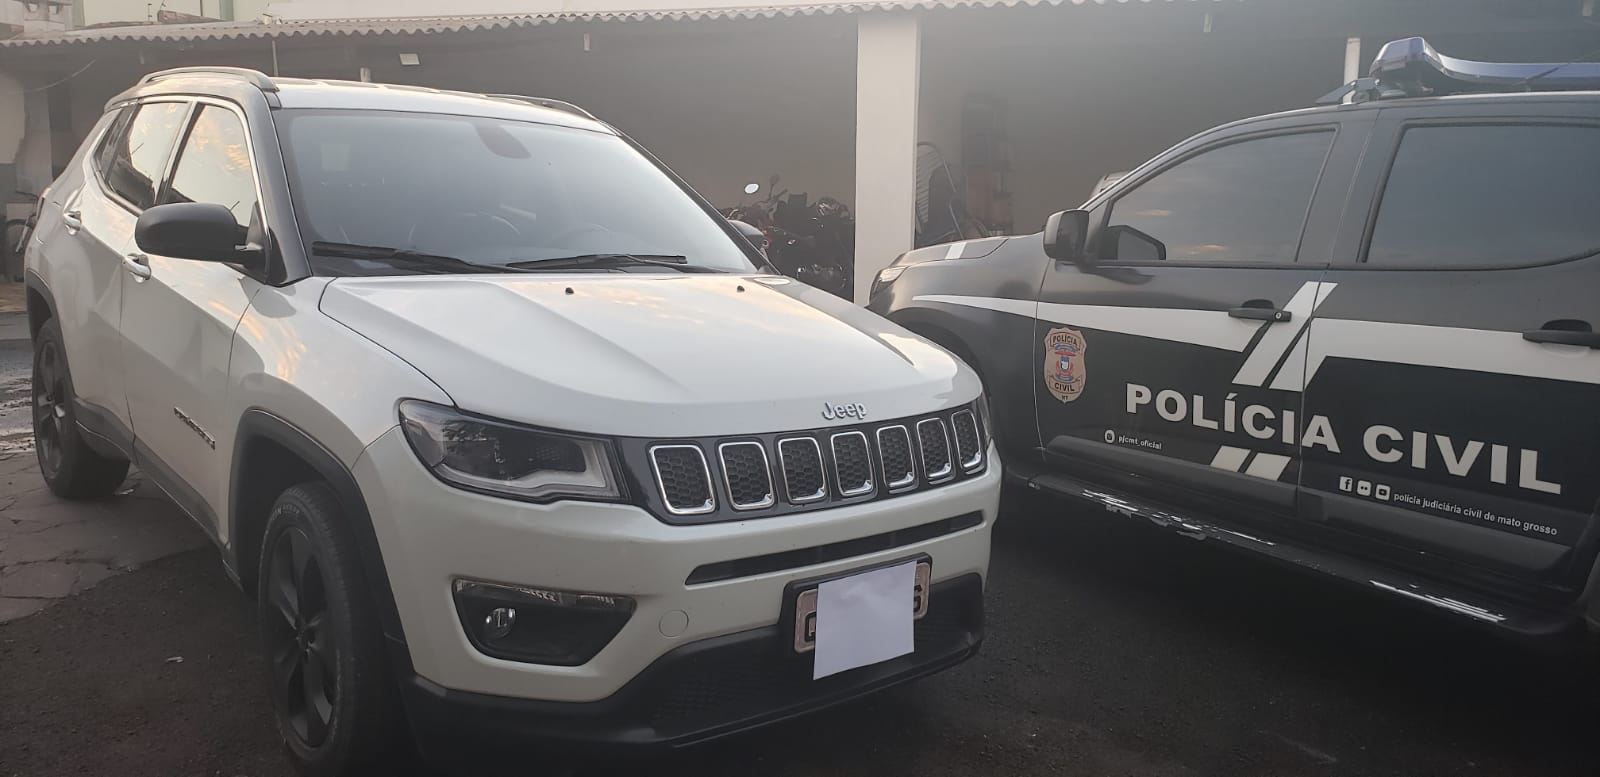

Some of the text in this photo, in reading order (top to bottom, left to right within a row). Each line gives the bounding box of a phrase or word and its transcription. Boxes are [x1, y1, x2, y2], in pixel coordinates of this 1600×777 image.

[1054, 382, 1075, 392] CIVIL
[821, 401, 867, 420] Jeep
[1118, 434, 1162, 450] pjcmt_oficial
[1126, 382, 1561, 495] POLÍCIA CIVIL
[1422, 498, 1462, 514] judiciária
[1463, 507, 1482, 519] civil
[1484, 511, 1496, 522] de
[1497, 515, 1521, 527] mato
[1523, 522, 1558, 536] grosso
